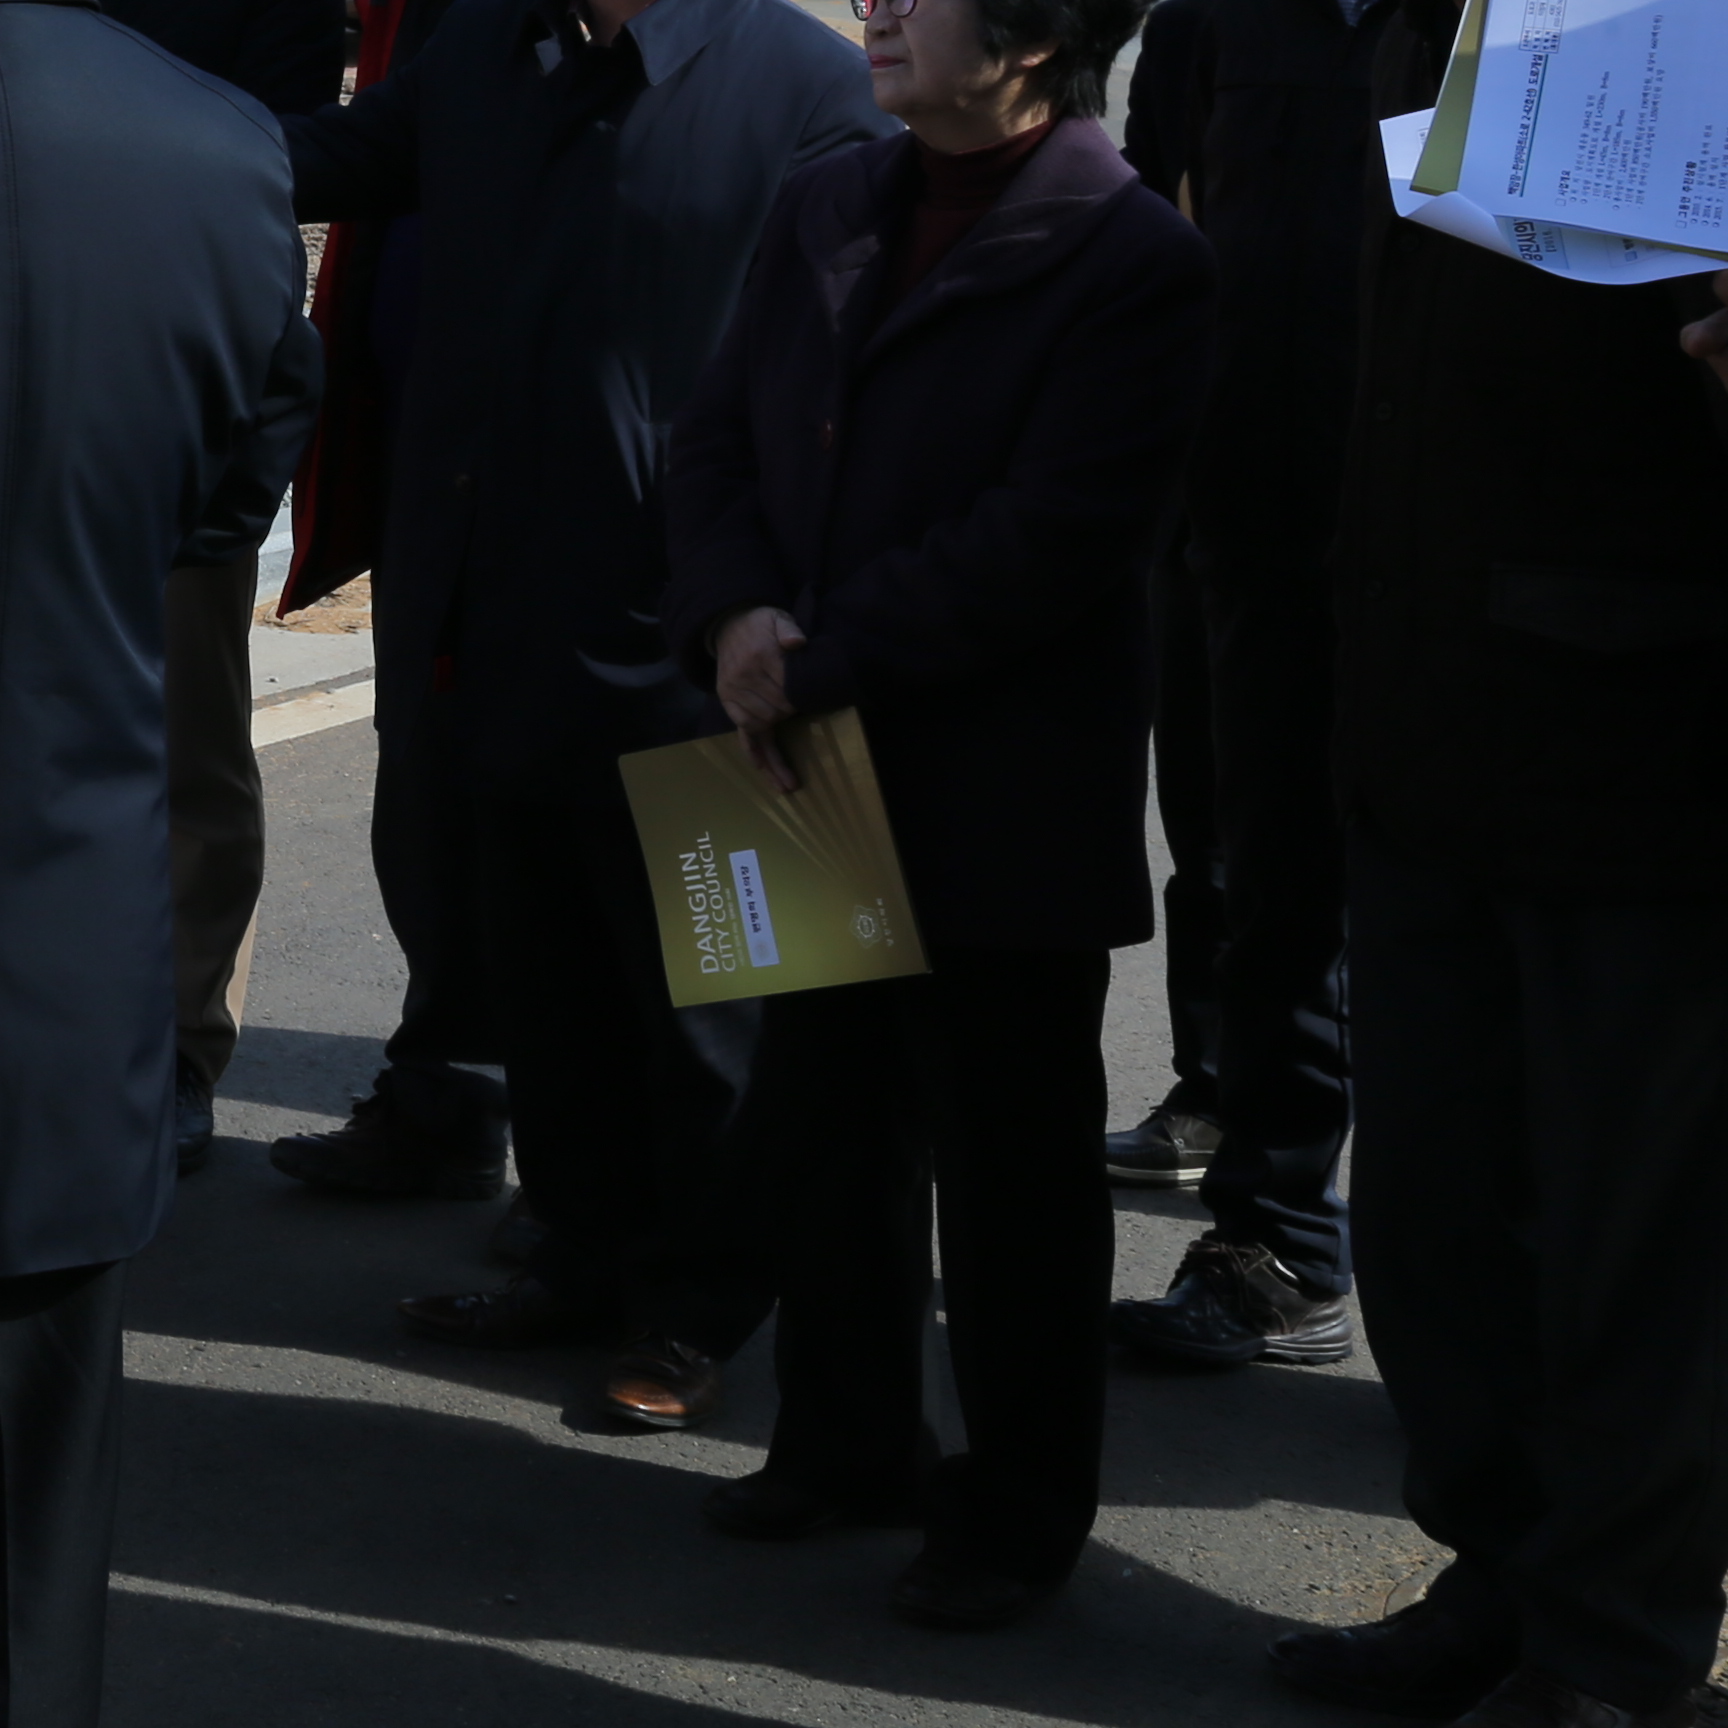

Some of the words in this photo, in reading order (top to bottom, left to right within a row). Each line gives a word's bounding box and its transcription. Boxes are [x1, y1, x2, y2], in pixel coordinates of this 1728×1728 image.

[679, 852, 720, 974] DANGJIN
[697, 831, 724, 924] COUNCIL
[713, 928, 736, 972] CITY
